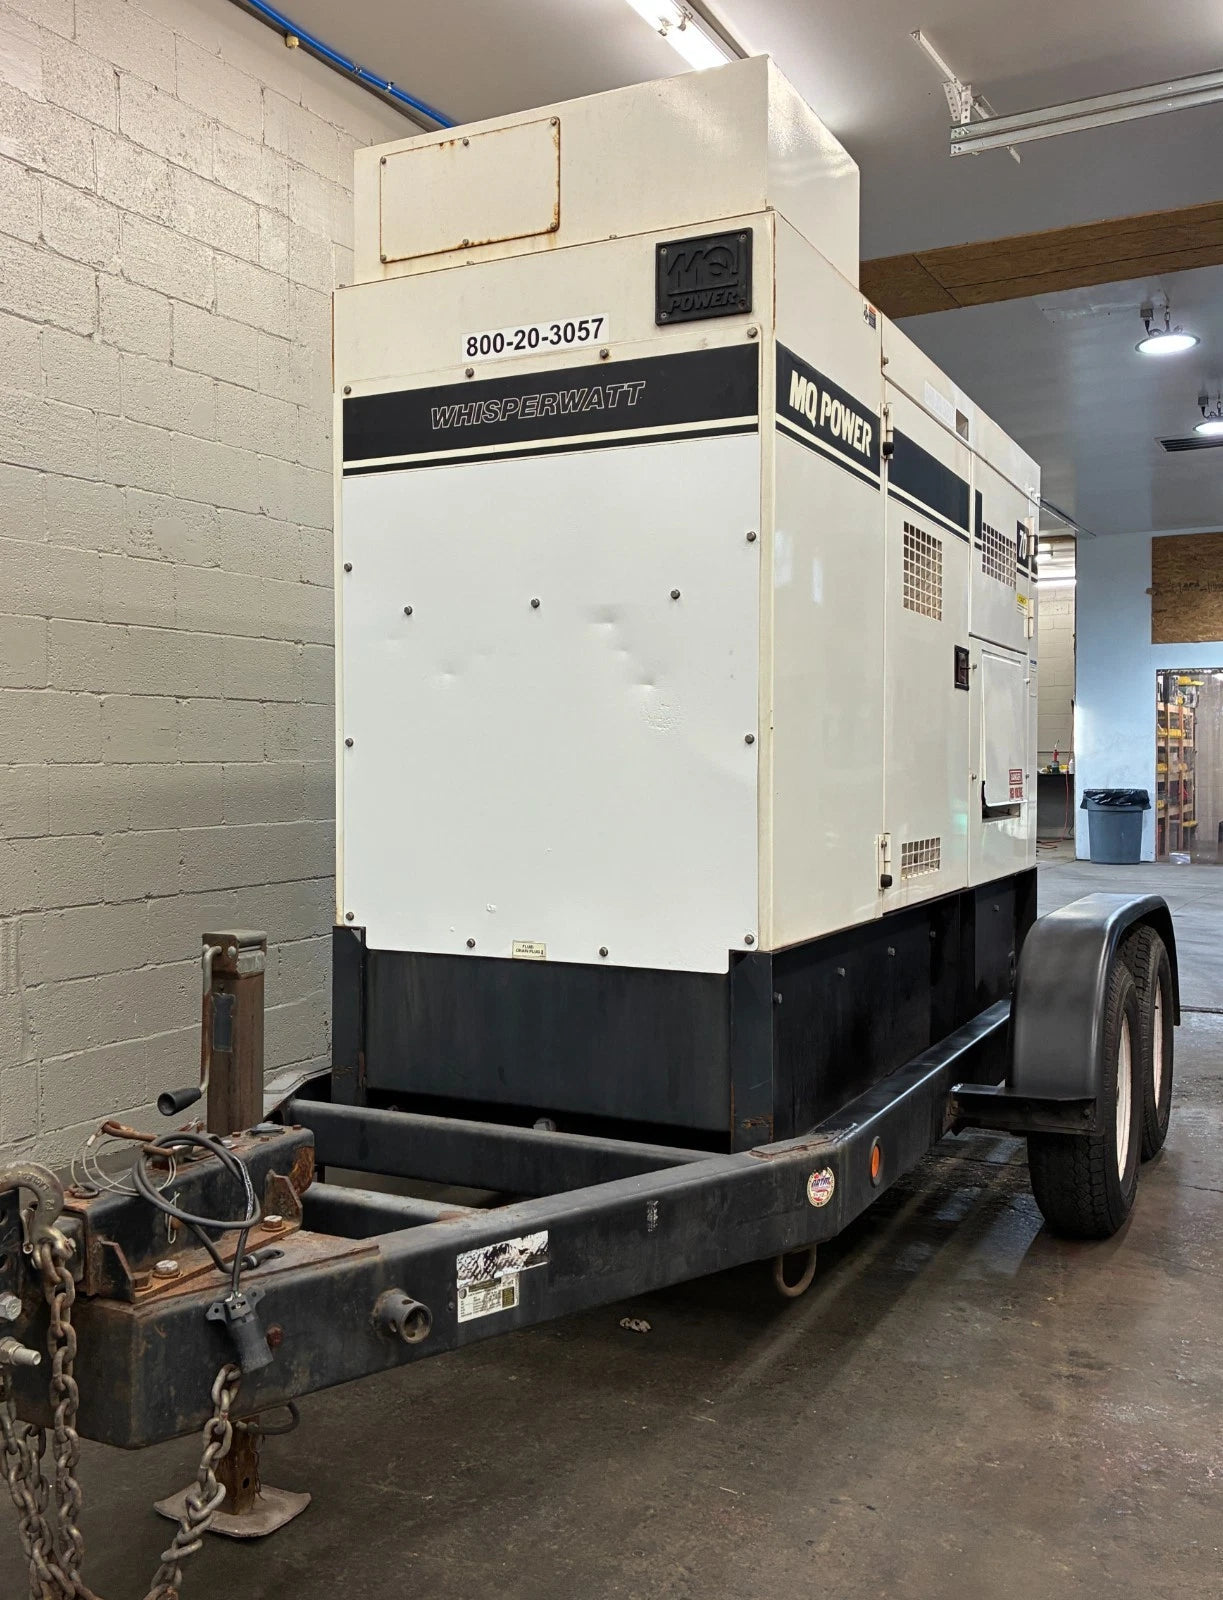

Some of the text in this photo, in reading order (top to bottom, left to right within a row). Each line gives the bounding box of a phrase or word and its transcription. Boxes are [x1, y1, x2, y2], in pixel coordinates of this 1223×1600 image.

[666, 243, 739, 290] MQ
[668, 291, 738, 315] POWER
[466, 317, 604, 357] 800-20-3057
[431, 381, 646, 430] WHISPERWATT
[789, 369, 818, 428] MQ
[819, 390, 872, 458] POWER
